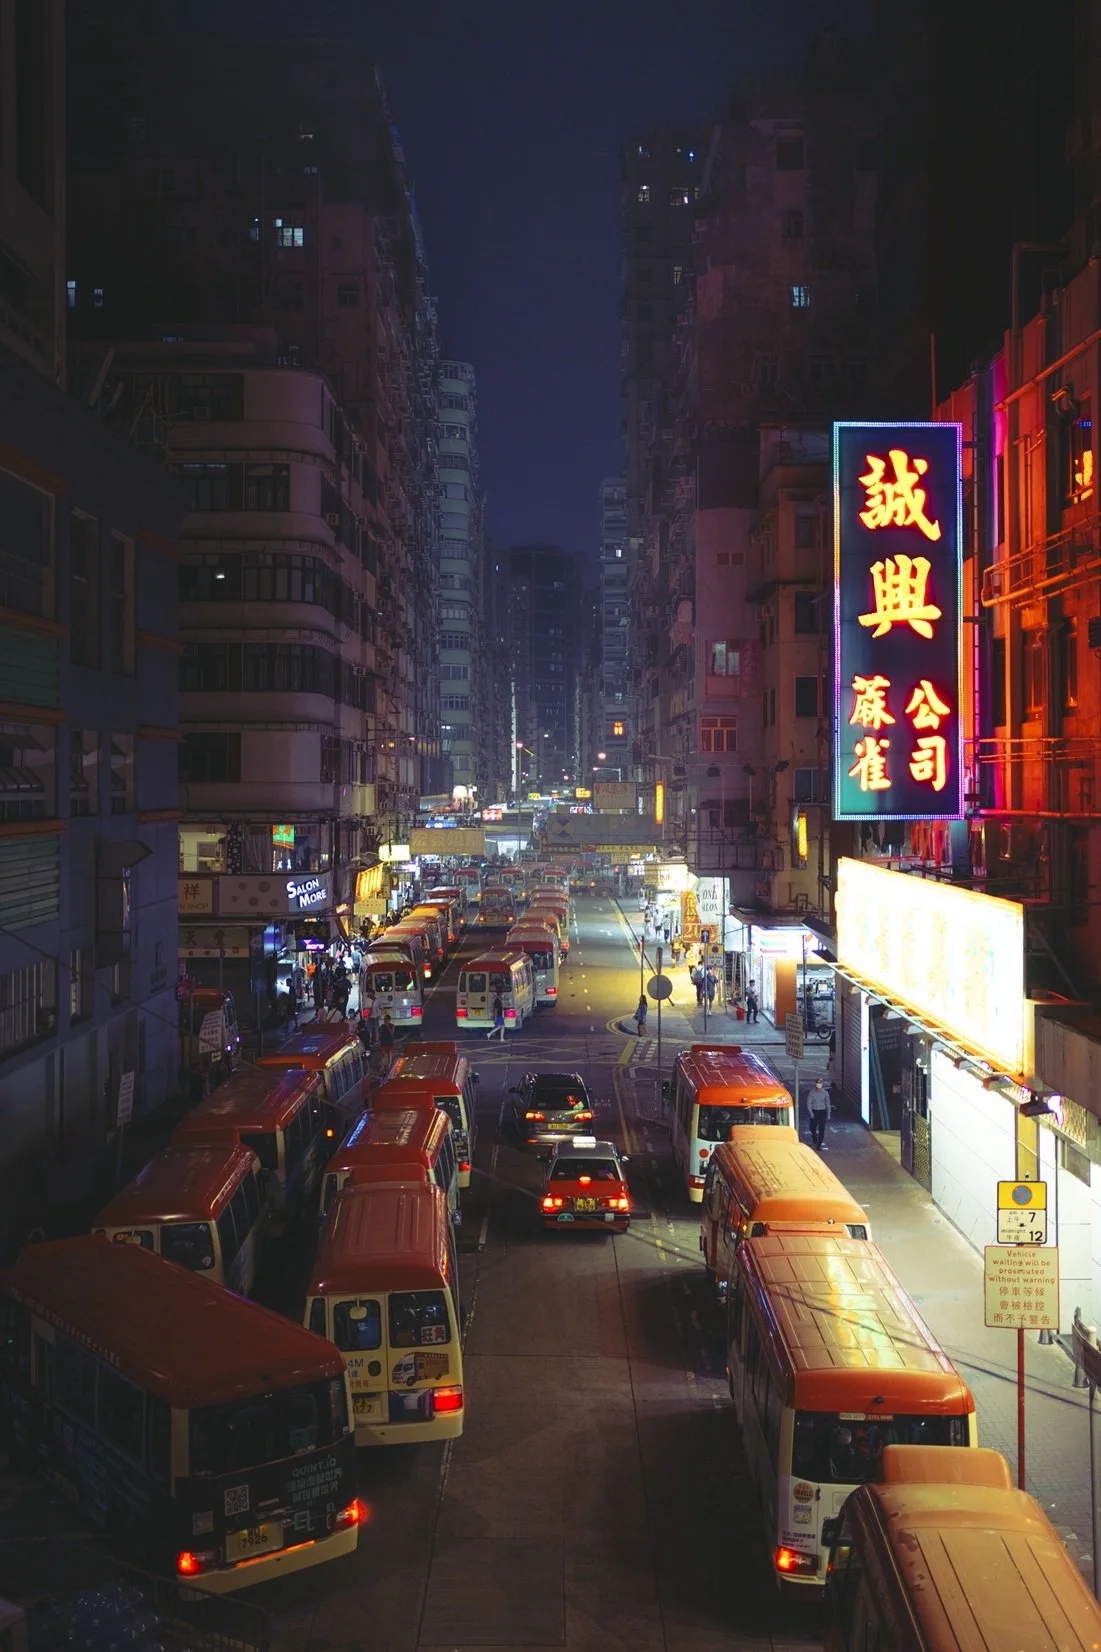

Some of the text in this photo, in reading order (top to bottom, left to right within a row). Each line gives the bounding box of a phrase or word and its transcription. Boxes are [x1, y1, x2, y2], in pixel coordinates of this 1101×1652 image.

[857, 448, 942, 640] 誠興
[904, 679, 951, 792] 公司
[286, 878, 320, 899] SALON
[298, 888, 327, 908] MORE
[1028, 1211, 1036, 1223] 7
[1029, 1230, 1043, 1242] 12
[1006, 1250, 1037, 1258] Vehicle
[992, 1259, 1023, 1267] waiting
[1022, 1277, 1055, 1285] warning
[999, 1286, 1045, 1297] 停車等候
[999, 1299, 1045, 1311] 會被檢控
[993, 1312, 1051, 1325] 而不予警告
[422, 1326, 445, 1342] 旺角
